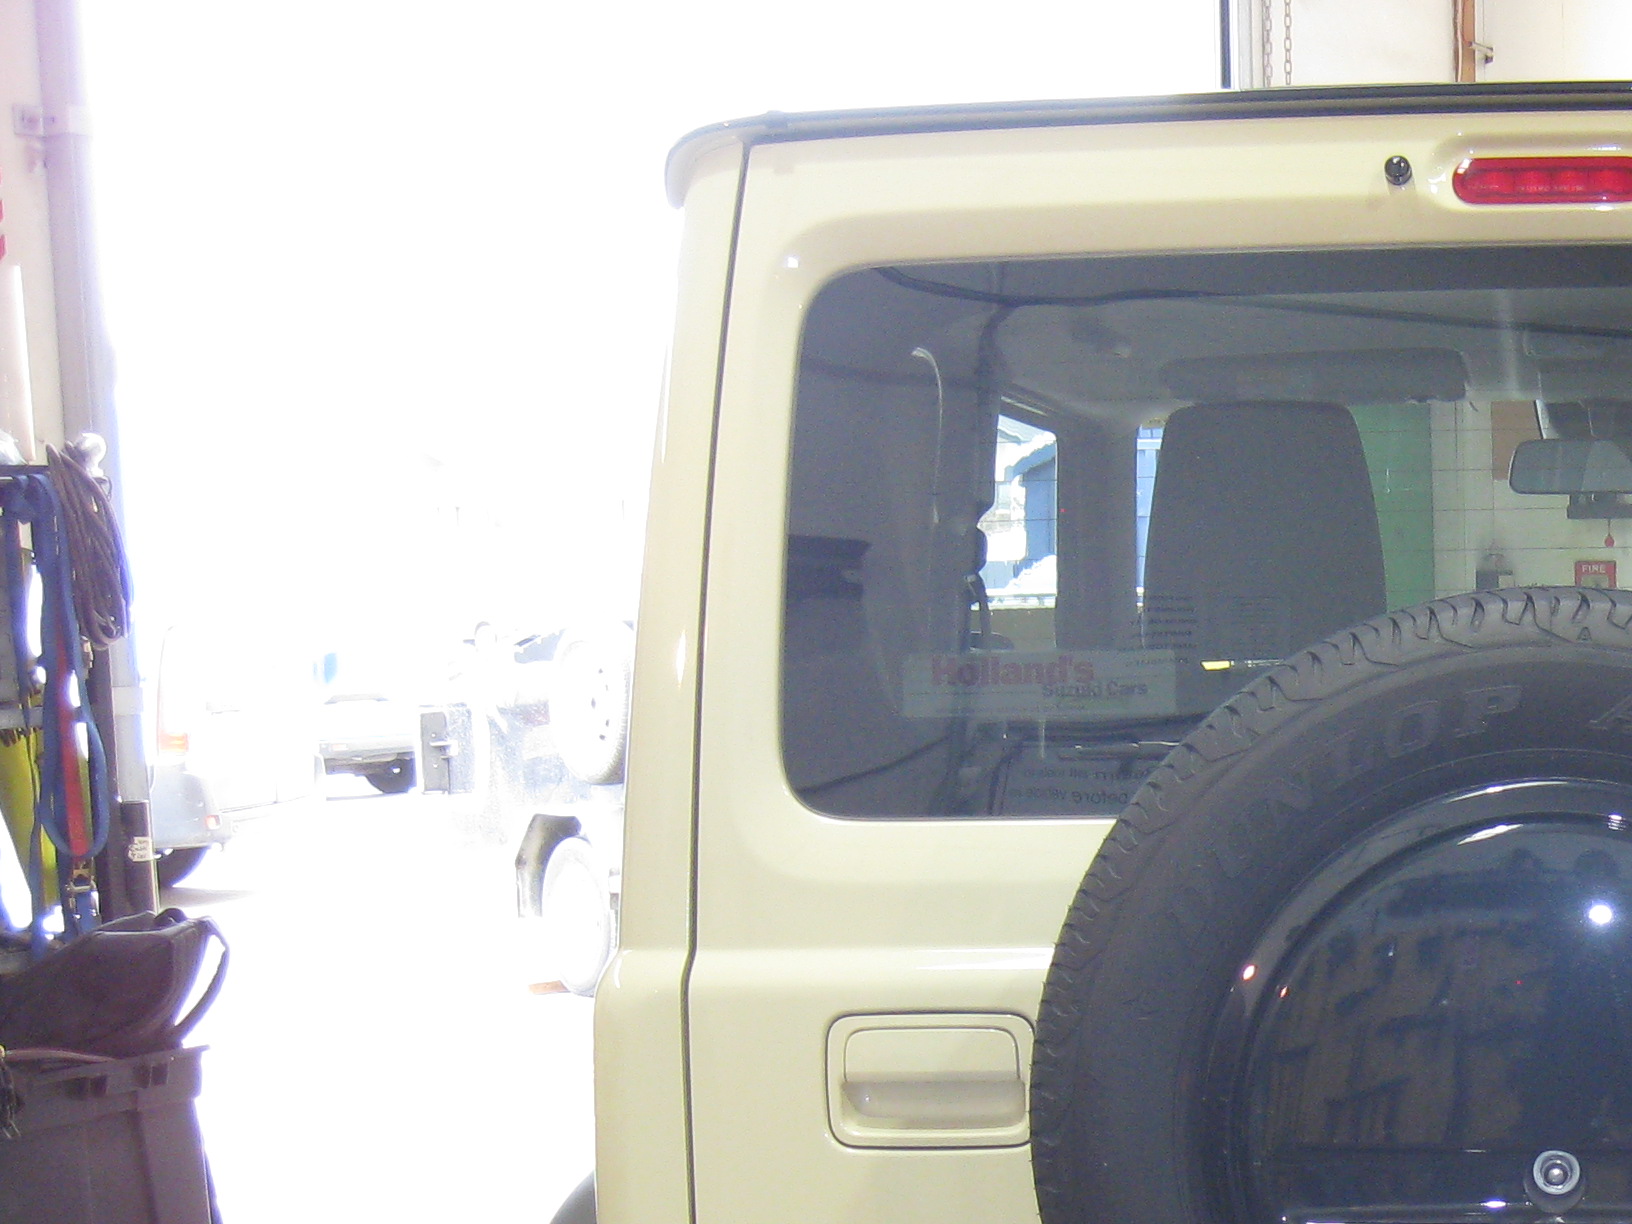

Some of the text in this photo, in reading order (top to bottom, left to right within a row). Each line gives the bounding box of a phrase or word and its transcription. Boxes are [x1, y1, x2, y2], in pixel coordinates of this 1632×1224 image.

[1582, 564, 1607, 574] FIRE
[932, 655, 1096, 687] Holland's
[1042, 679, 1148, 698] Suzuki Cars
